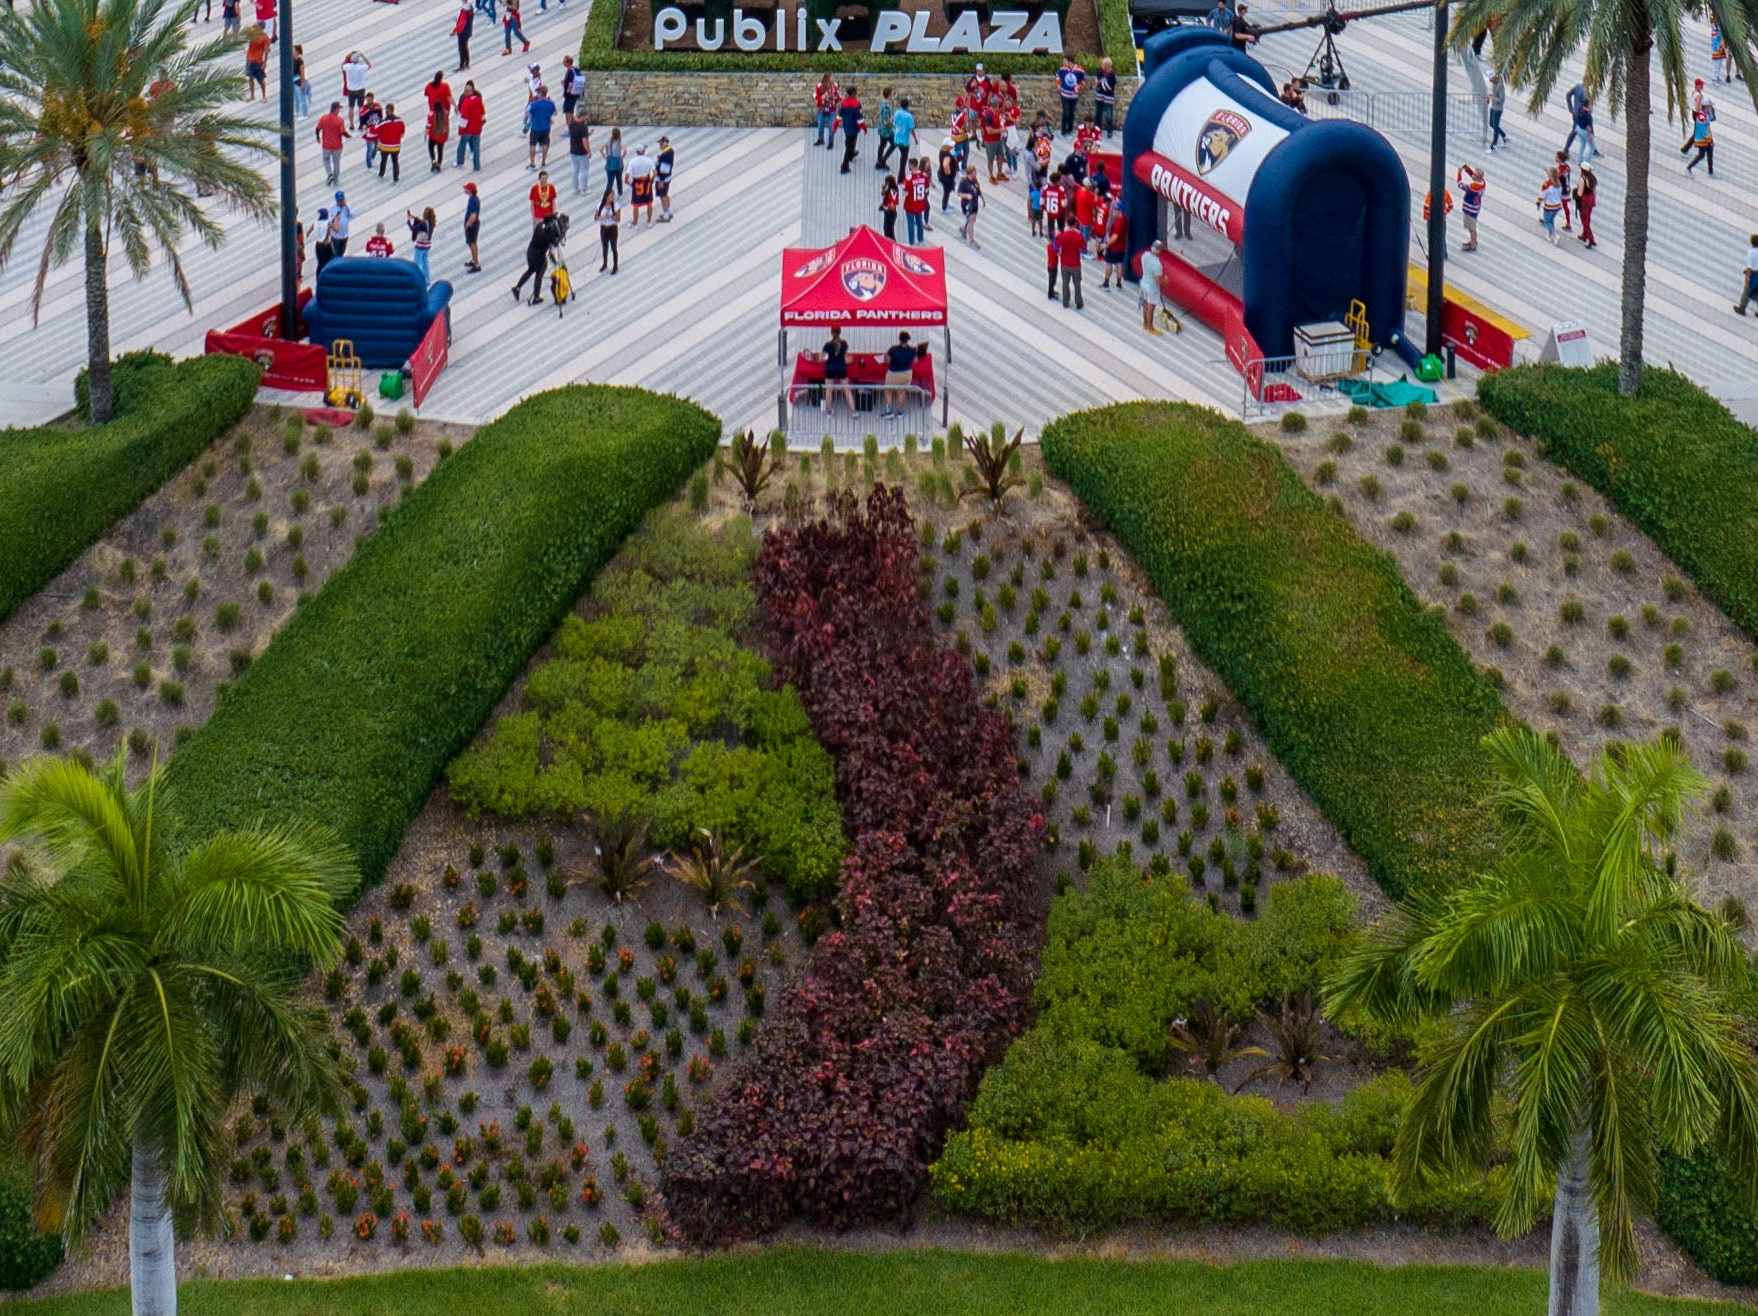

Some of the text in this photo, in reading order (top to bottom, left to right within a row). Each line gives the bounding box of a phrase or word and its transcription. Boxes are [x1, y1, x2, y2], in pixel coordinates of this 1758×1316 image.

[654, 7, 1063, 54] Publix PLAZA
[1150, 163, 1230, 236] PANTHERS
[784, 310, 943, 321] FLORIDA PANTHERS
